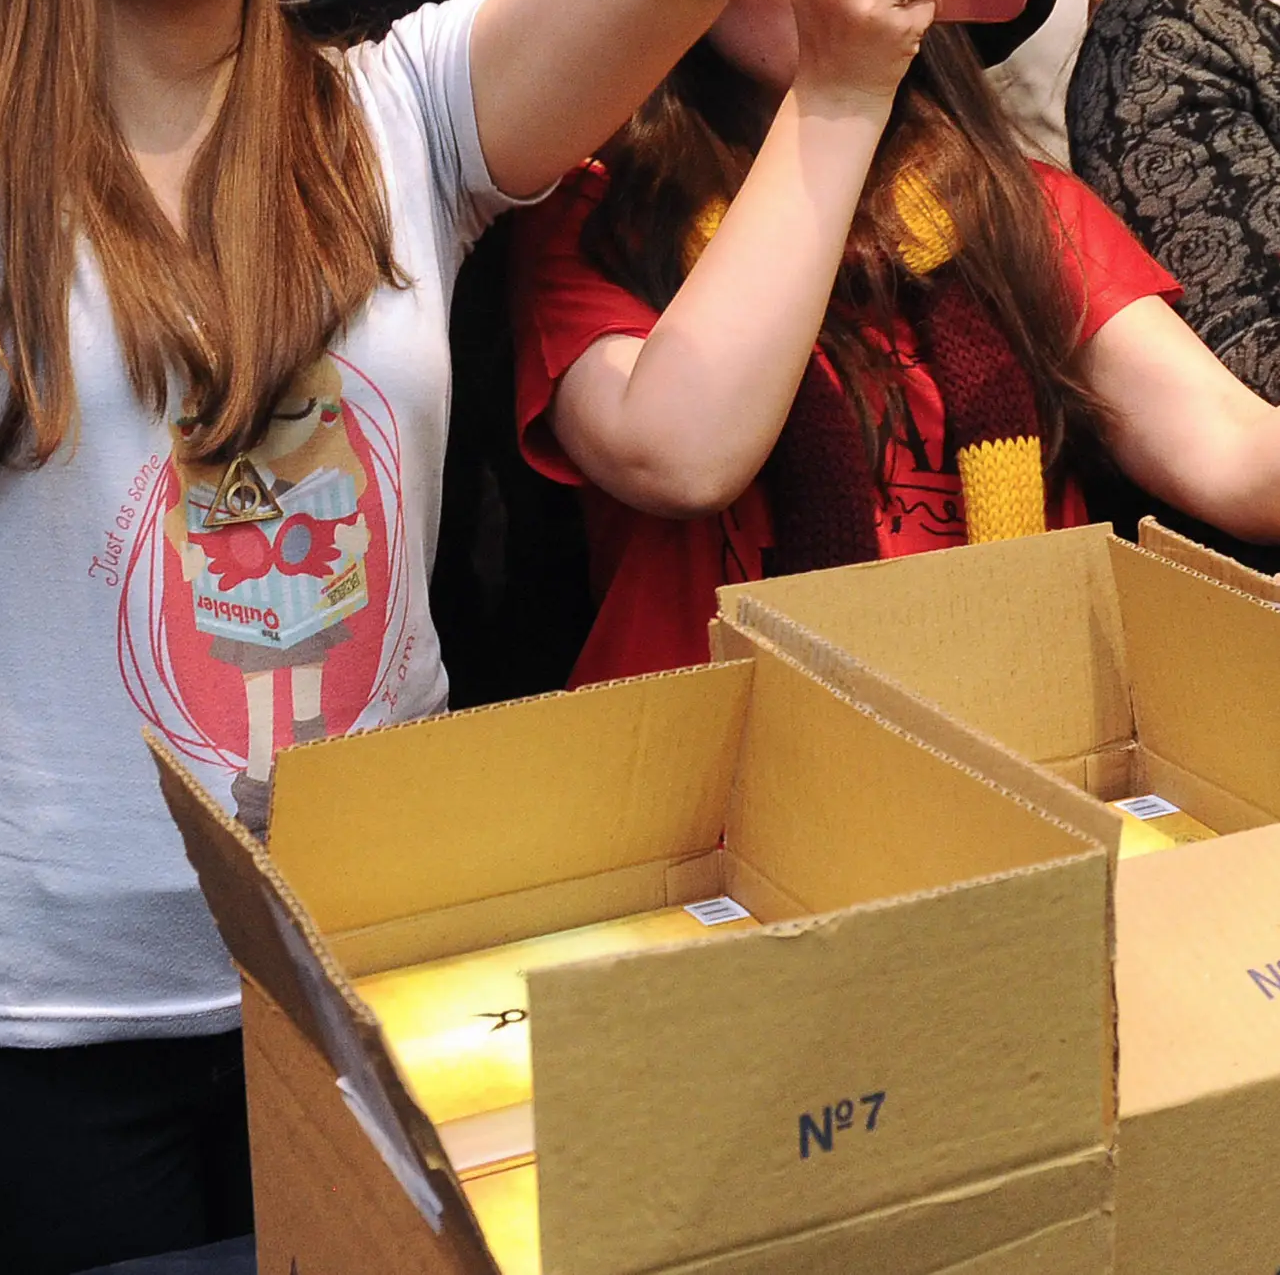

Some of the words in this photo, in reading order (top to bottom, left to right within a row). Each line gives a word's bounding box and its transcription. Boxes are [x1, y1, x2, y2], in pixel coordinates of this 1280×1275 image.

[88, 530, 125, 587] Just
[115, 505, 135, 530] as
[128, 454, 161, 502] sane
[197, 594, 281, 630] Quibbler
[261, 629, 281, 642] The
